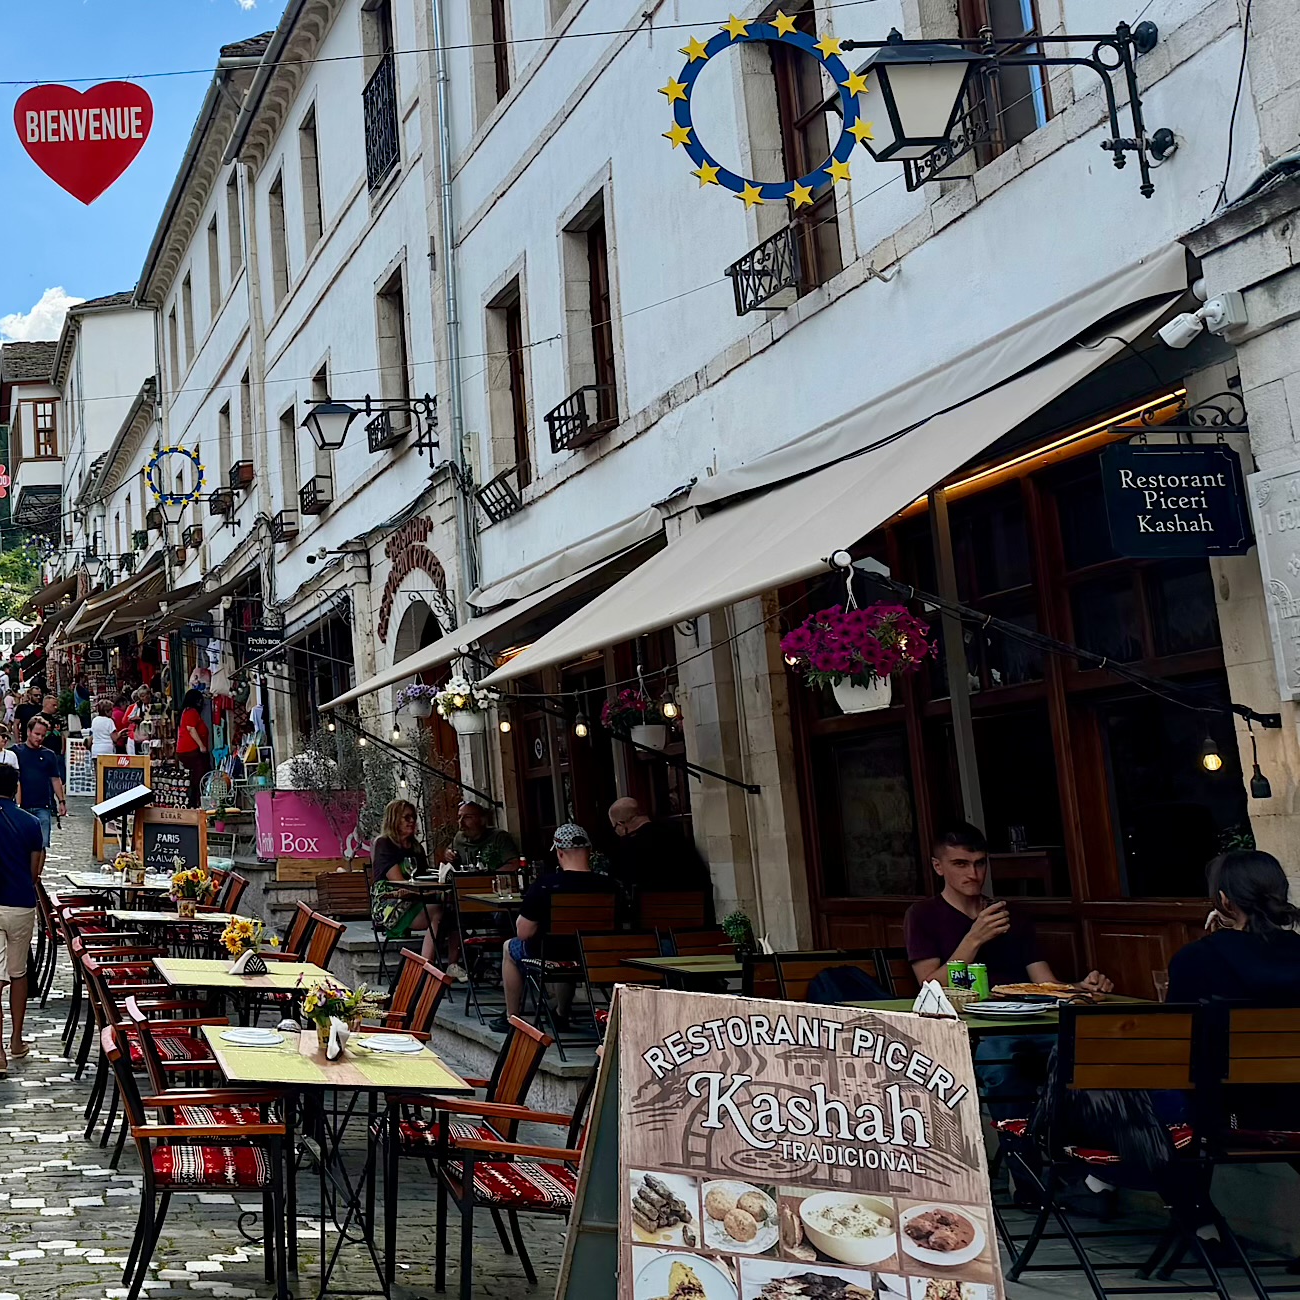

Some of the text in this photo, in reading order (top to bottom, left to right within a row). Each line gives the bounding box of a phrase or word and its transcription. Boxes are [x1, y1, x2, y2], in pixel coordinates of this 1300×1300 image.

[25, 106, 143, 143] BIENVENUE
[1118, 469, 1226, 489] Restorant
[1143, 490, 1208, 509] Piceri
[1137, 513, 1215, 533] Kashah
[117, 756, 130, 766] illy
[107, 769, 144, 781] FROZEN
[157, 833, 180, 843] PARIS
[642, 1014, 969, 1110] RESTORANT PICERI
[686, 1070, 932, 1150] Kashah
[778, 1139, 926, 1175] TRADICIONAL
